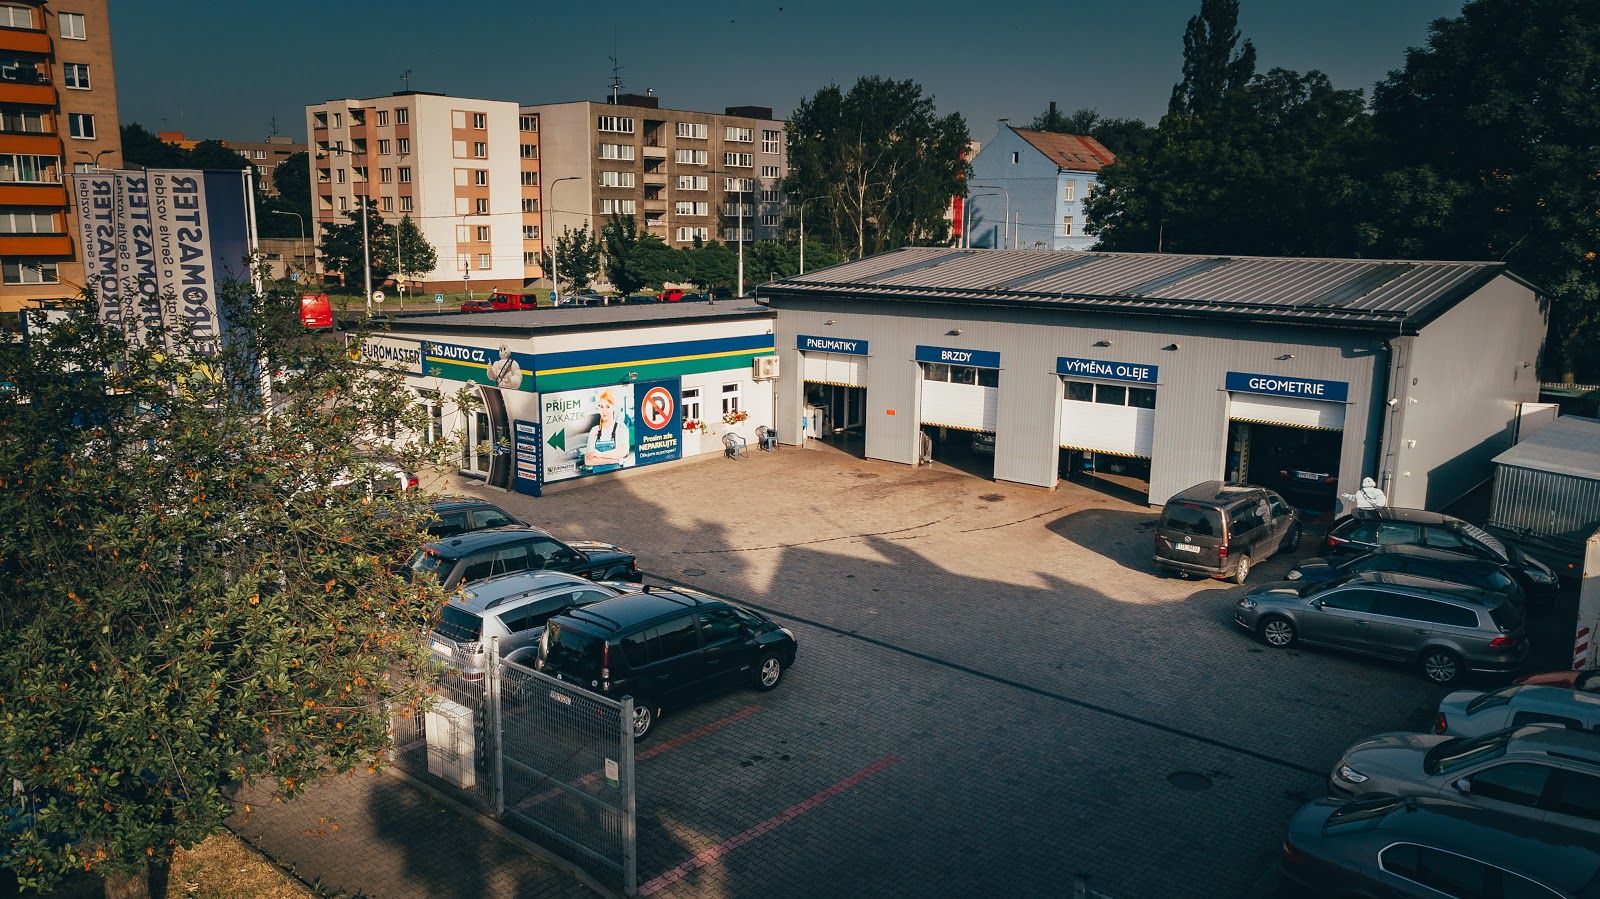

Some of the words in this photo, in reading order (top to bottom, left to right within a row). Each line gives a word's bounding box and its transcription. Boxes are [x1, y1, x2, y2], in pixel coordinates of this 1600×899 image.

[807, 338, 857, 351] PNEUMATIKY
[362, 343, 420, 364] EUROMASTER
[444, 346, 470, 360] AUTO
[471, 350, 485, 362] CZ
[941, 351, 972, 362] BRZDY
[1066, 360, 1113, 376] VÝMĚNA
[1116, 366, 1149, 379] OLEJE
[1249, 378, 1325, 395] GEOMETRIE
[546, 398, 581, 413] PŘÍJEM
[638, 439, 677, 451] NEPARKUJTE
